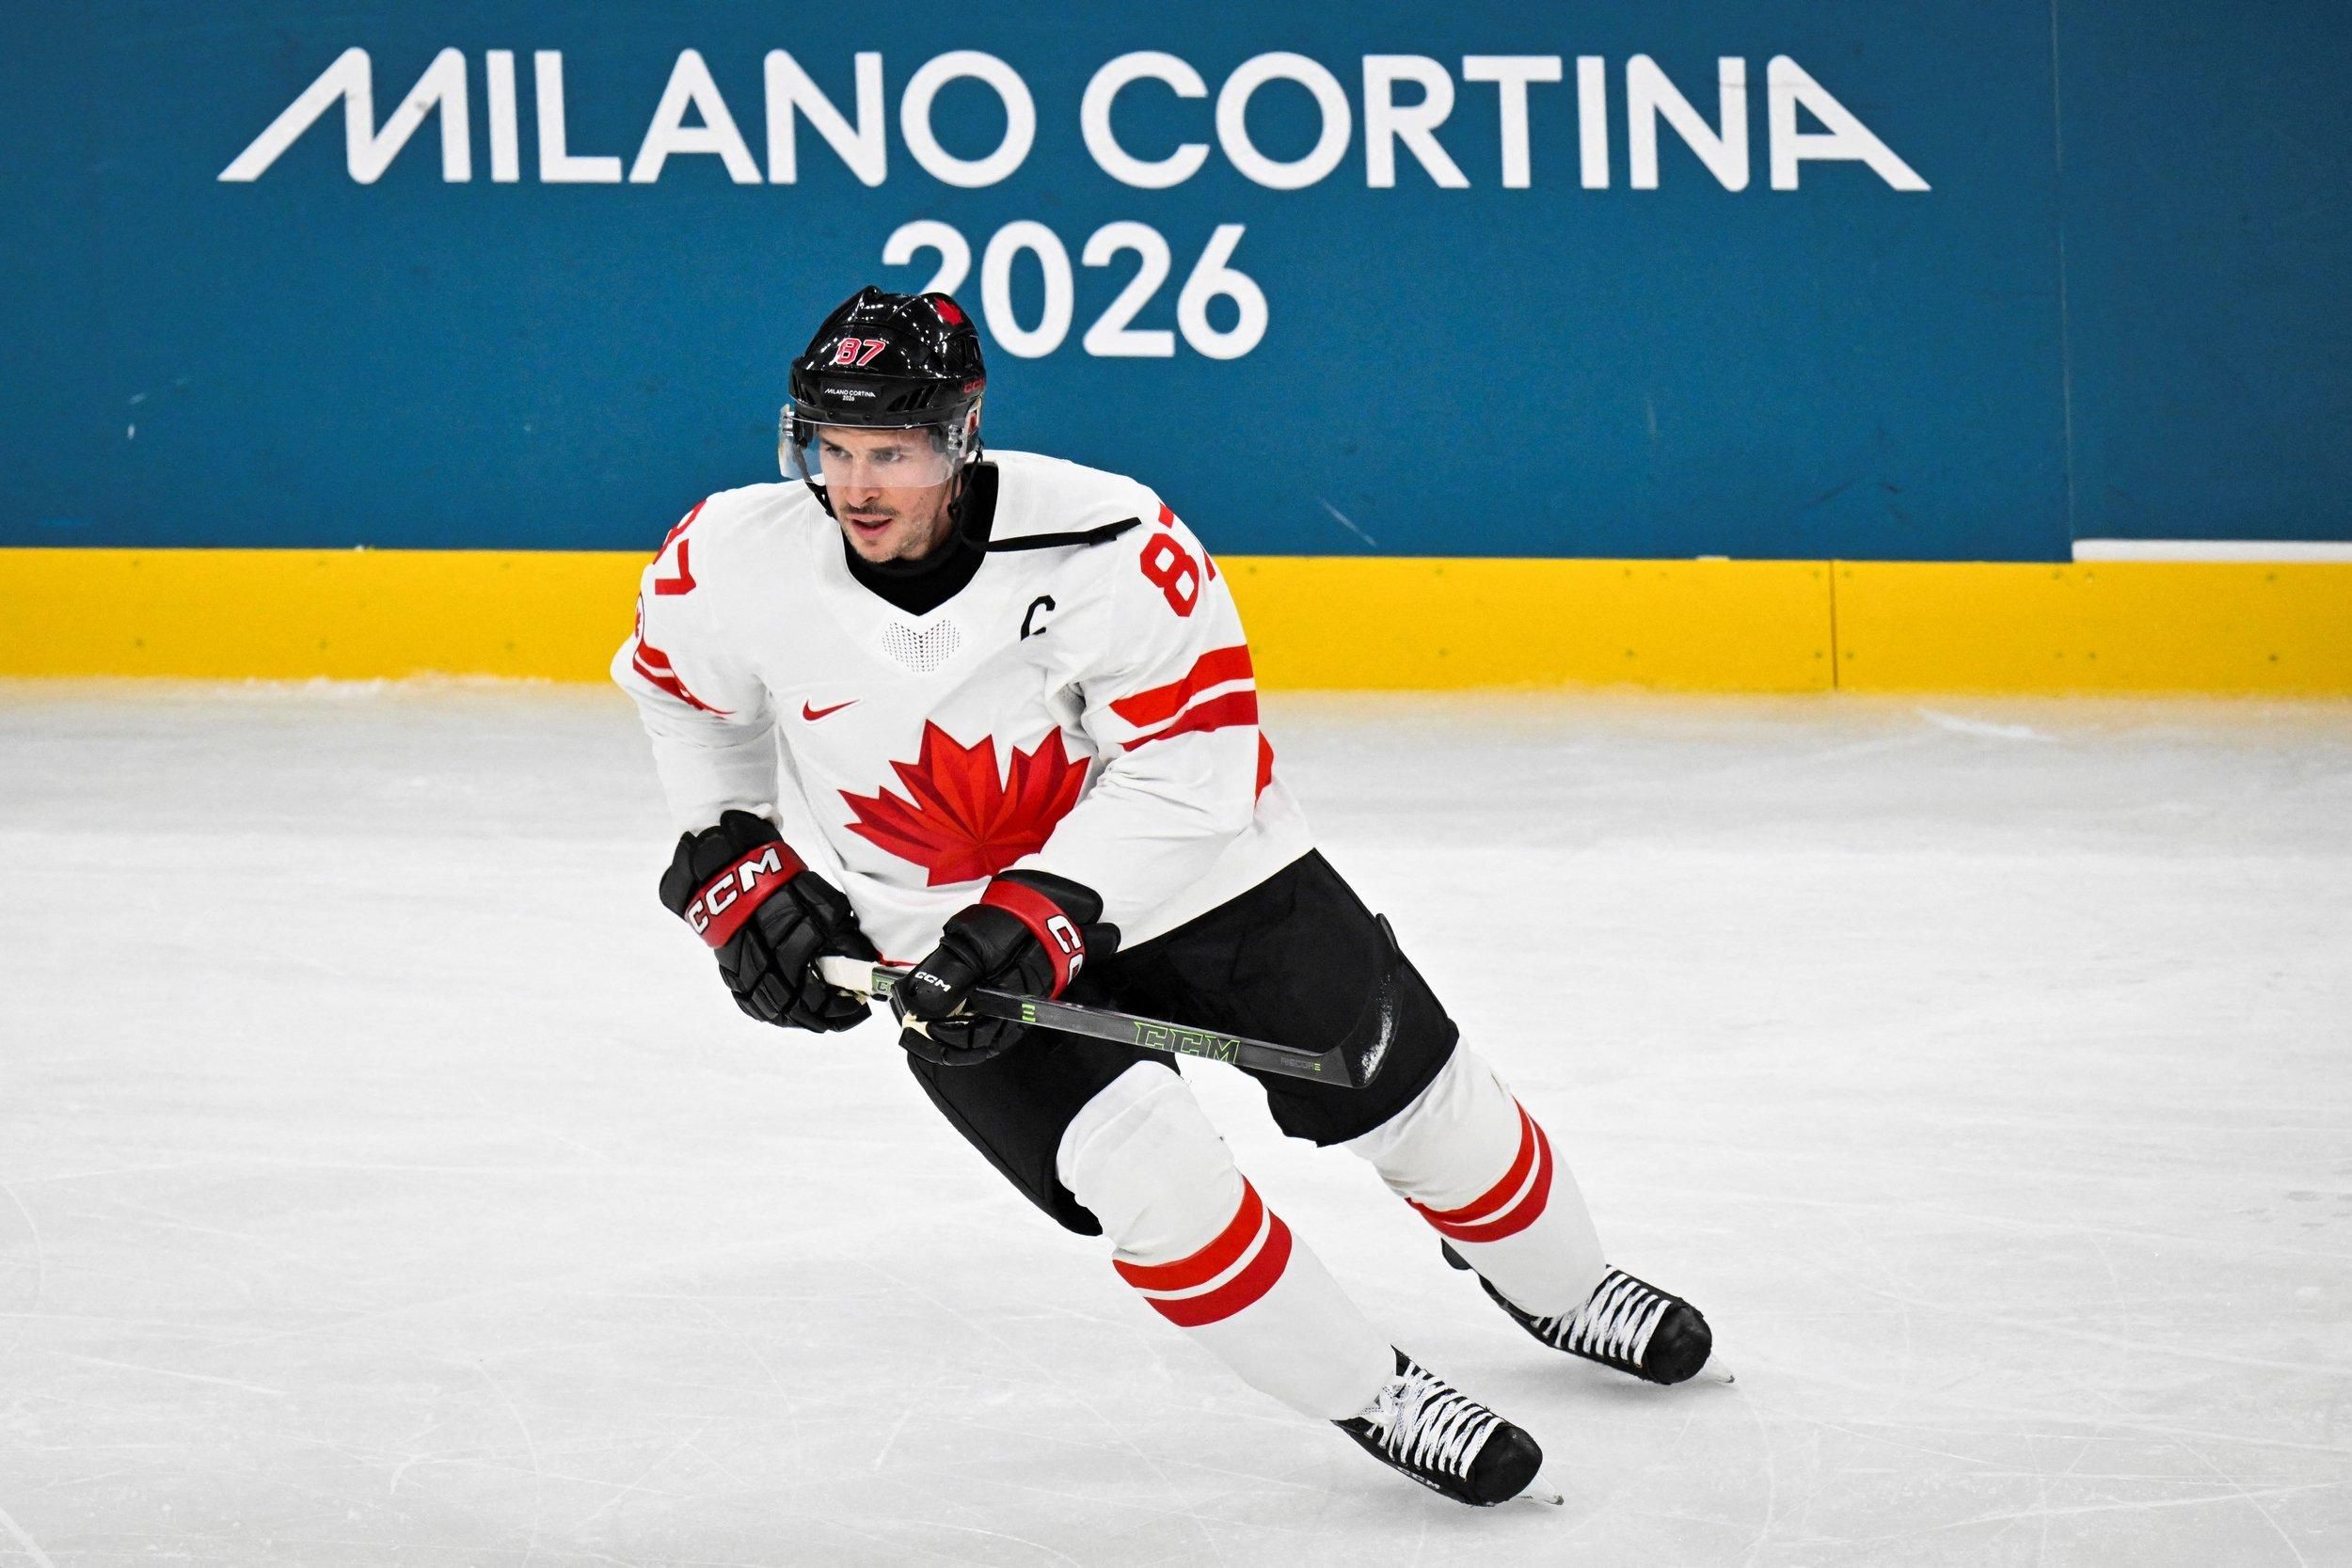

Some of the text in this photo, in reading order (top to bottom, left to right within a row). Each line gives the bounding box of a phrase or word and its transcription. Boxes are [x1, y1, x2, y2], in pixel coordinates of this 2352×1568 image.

[219, 48, 1931, 192] MILANO CORTINA
[883, 221, 1268, 360] 2026
[835, 337, 886, 367] 87
[824, 388, 877, 398] MILANO CORTINA
[1020, 594, 1056, 641] C
[688, 847, 783, 935] CCM
[914, 971, 952, 992] CCM
[1134, 1021, 1241, 1065] CCM
